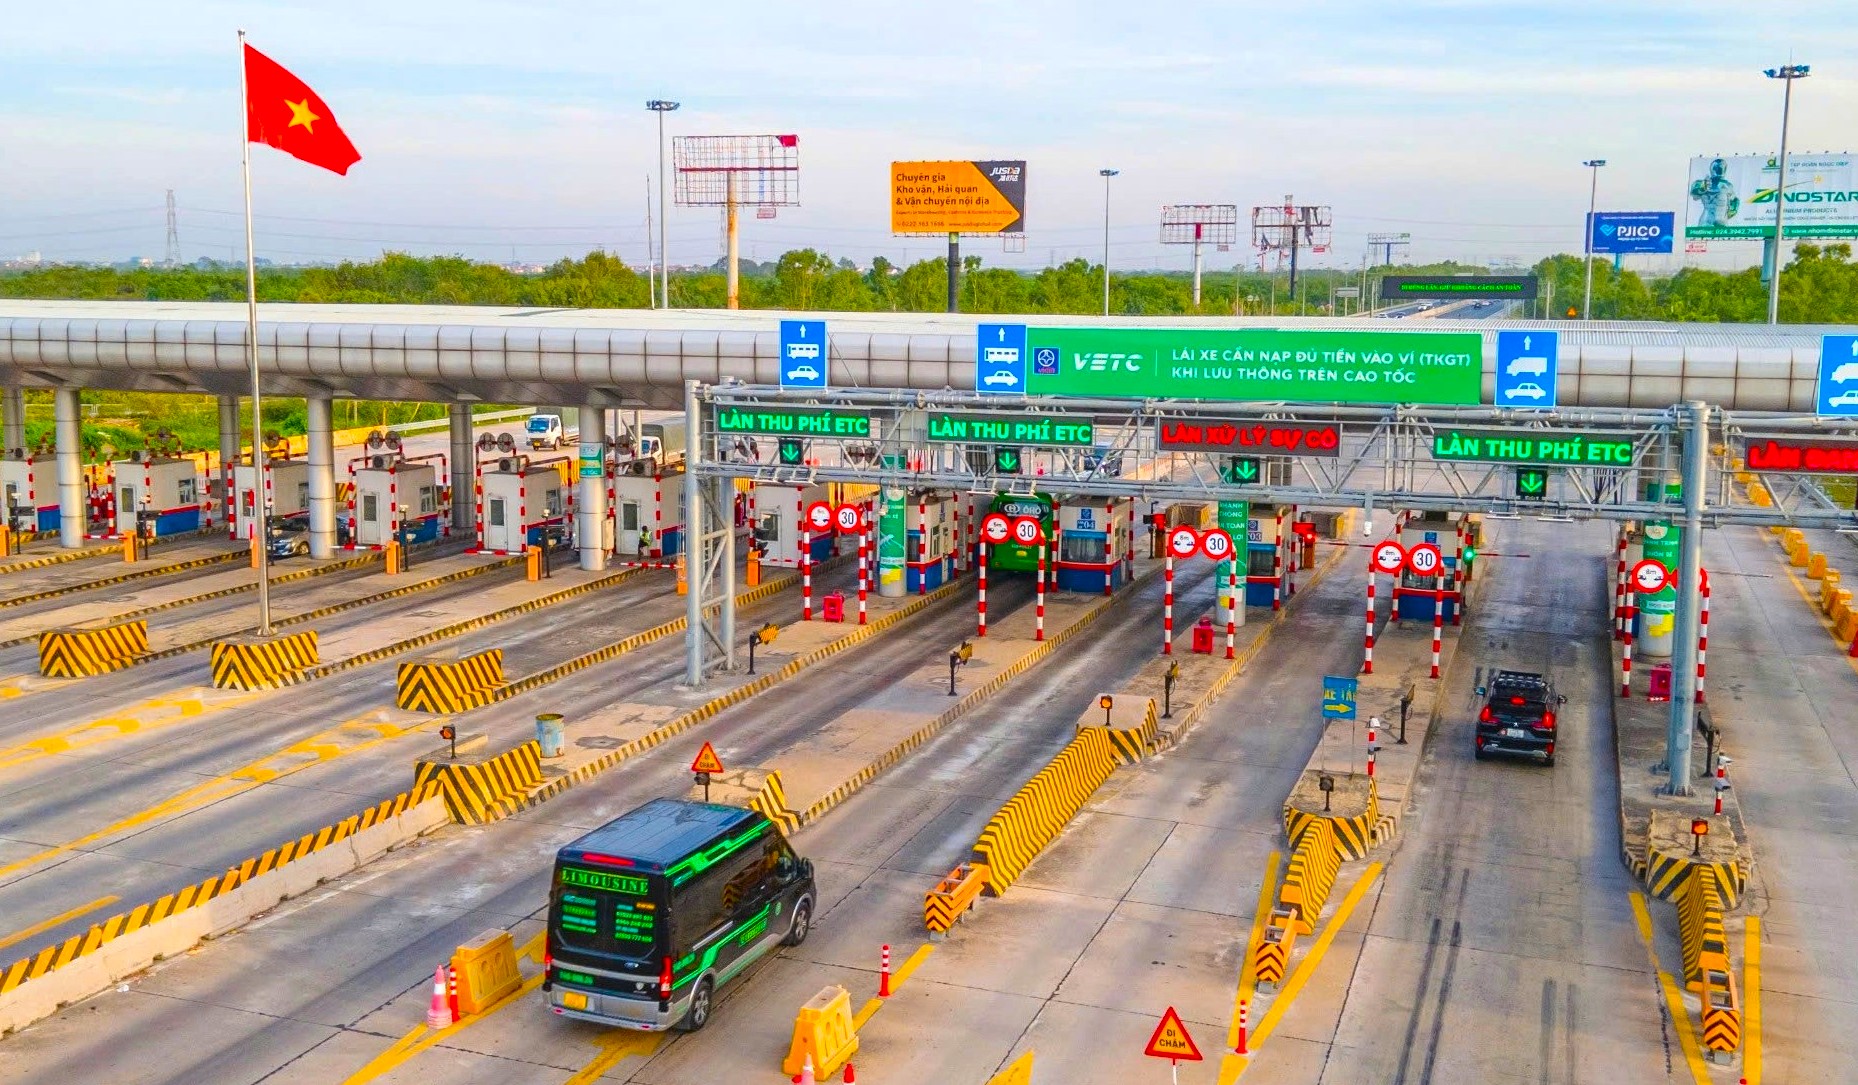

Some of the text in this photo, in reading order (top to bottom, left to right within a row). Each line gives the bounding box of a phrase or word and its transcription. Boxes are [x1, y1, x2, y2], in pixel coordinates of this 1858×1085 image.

[932, 174, 946, 183] gia
[896, 184, 978, 195] Kho vận, Hải quan
[905, 197, 921, 207] Vận
[923, 196, 957, 206] chuyển
[958, 197, 973, 207] nội
[975, 197, 990, 207] địa
[1617, 225, 1661, 237] PJICO
[1074, 353, 1143, 371] VETC
[1172, 347, 1195, 361] LÁI
[1199, 350, 1217, 361] XE
[1223, 346, 1254, 361] CẦN
[1260, 351, 1291, 365] NẠP
[1296, 348, 1317, 363] ĐỦ
[1361, 349, 1393, 364] VÀO
[1399, 351, 1415, 365] VÍ
[1419, 353, 1471, 367] (TKGT)
[1172, 366, 1416, 384] KHI LƯU THÔNG TRÊN CAO TỐC
[720, 409, 867, 434] LÀN THU PHÍ ETC
[931, 416, 1091, 442] LÀN THU PHÍ ETC
[1162, 421, 1202, 444] LÀN
[1240, 424, 1267, 446] LÝ
[1270, 429, 1302, 450] SỰ
[1436, 433, 1631, 462] LÀN THU PHÍ ETC
[841, 511, 854, 525] 30
[1020, 524, 1034, 538] 30
[1209, 538, 1224, 551] 30
[1416, 552, 1433, 567] 30
[562, 870, 649, 892] LIMOUSINE
[1166, 1029, 1176, 1037] ĐI
